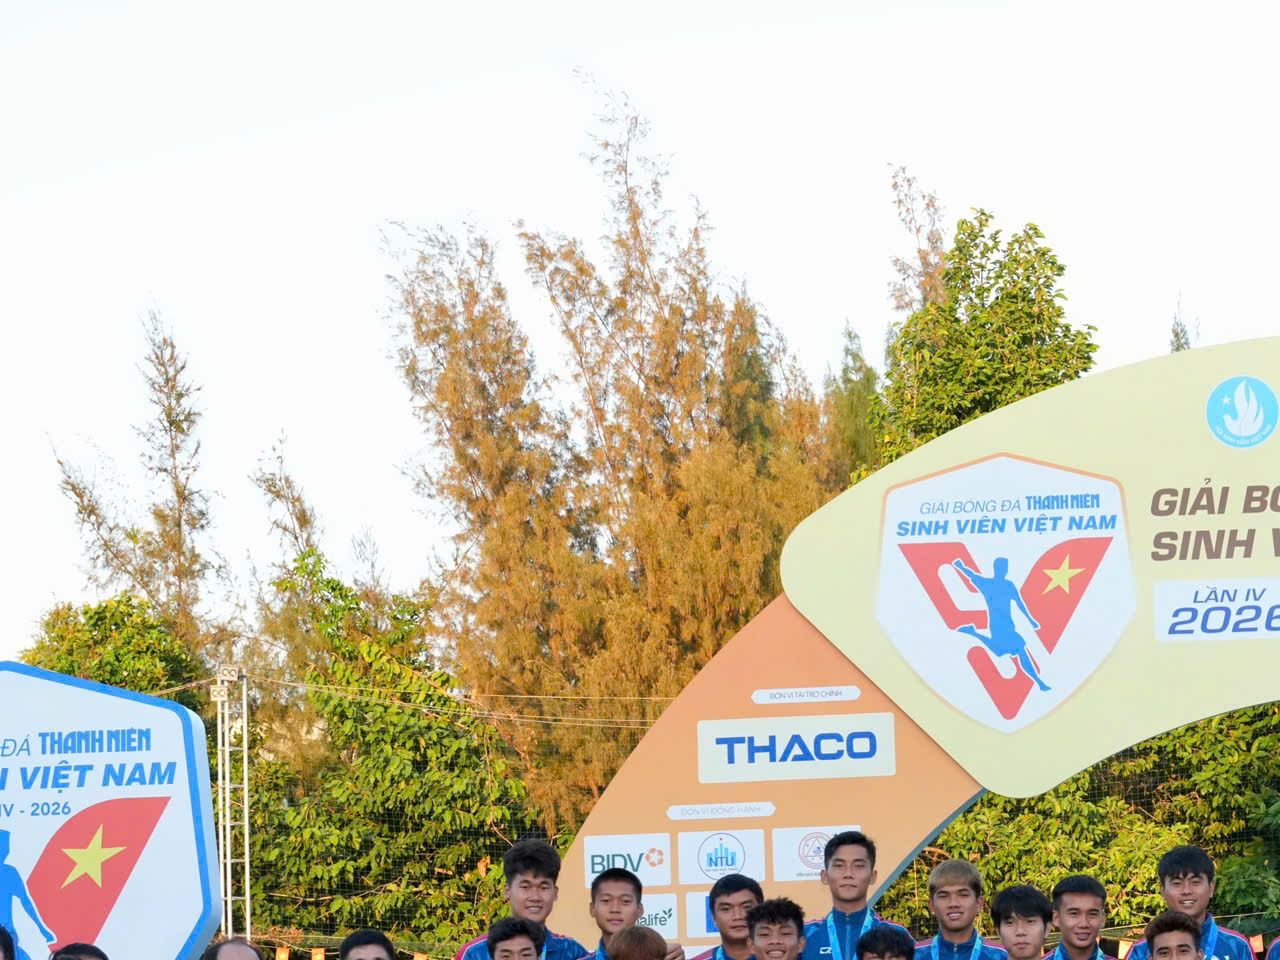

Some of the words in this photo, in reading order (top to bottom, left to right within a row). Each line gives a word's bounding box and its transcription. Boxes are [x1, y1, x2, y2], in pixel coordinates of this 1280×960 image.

[1000, 496, 1022, 512] ĐÁ
[1025, 495, 1069, 511] THANH
[1150, 478, 1230, 516] GIẢI
[896, 520, 949, 536] SINH
[956, 516, 1006, 534] VIÊN
[1014, 514, 1062, 535] VIỆT
[1068, 514, 1118, 531] NAM
[1151, 529, 1256, 561] SINH
[1193, 586, 1238, 604] LẦN
[1245, 588, 1267, 602] IV
[1, 734, 31, 757] ĐÁ
[38, 730, 104, 755] THANH
[106, 728, 151, 752] NIÊN
[715, 731, 877, 764] THACO
[20, 760, 94, 794] VIỆT
[102, 762, 176, 786] NAM
[30, 802, 71, 816] 2026
[590, 852, 645, 874] BIDV
[708, 856, 735, 867] NTU
